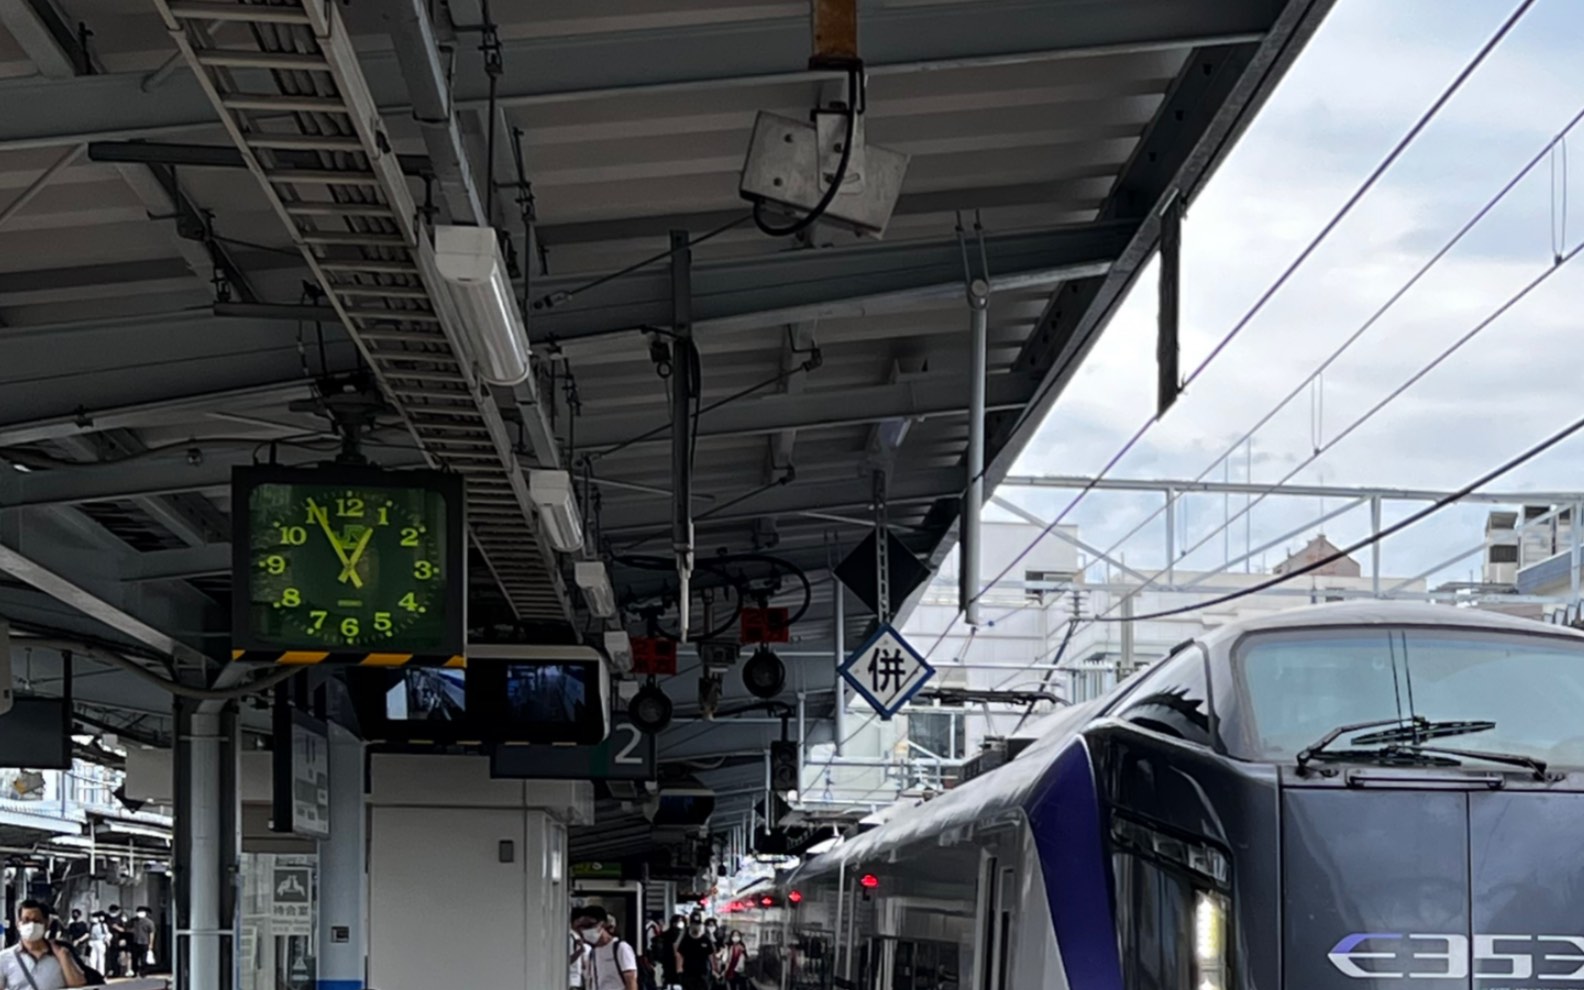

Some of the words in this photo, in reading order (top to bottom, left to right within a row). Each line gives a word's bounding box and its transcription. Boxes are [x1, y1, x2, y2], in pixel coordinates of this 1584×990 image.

[335, 499, 364, 518] 12
[377, 507, 389, 525] 1
[279, 526, 308, 545] 10
[400, 528, 419, 547] 2
[266, 555, 286, 575] 9
[413, 560, 433, 580] 3
[281, 588, 301, 608] 8
[398, 592, 418, 611] 4
[309, 611, 328, 630] 7
[340, 617, 360, 637] 6
[373, 612, 392, 631] 5
[867, 647, 906, 693] 併
[615, 723, 643, 764] 2
